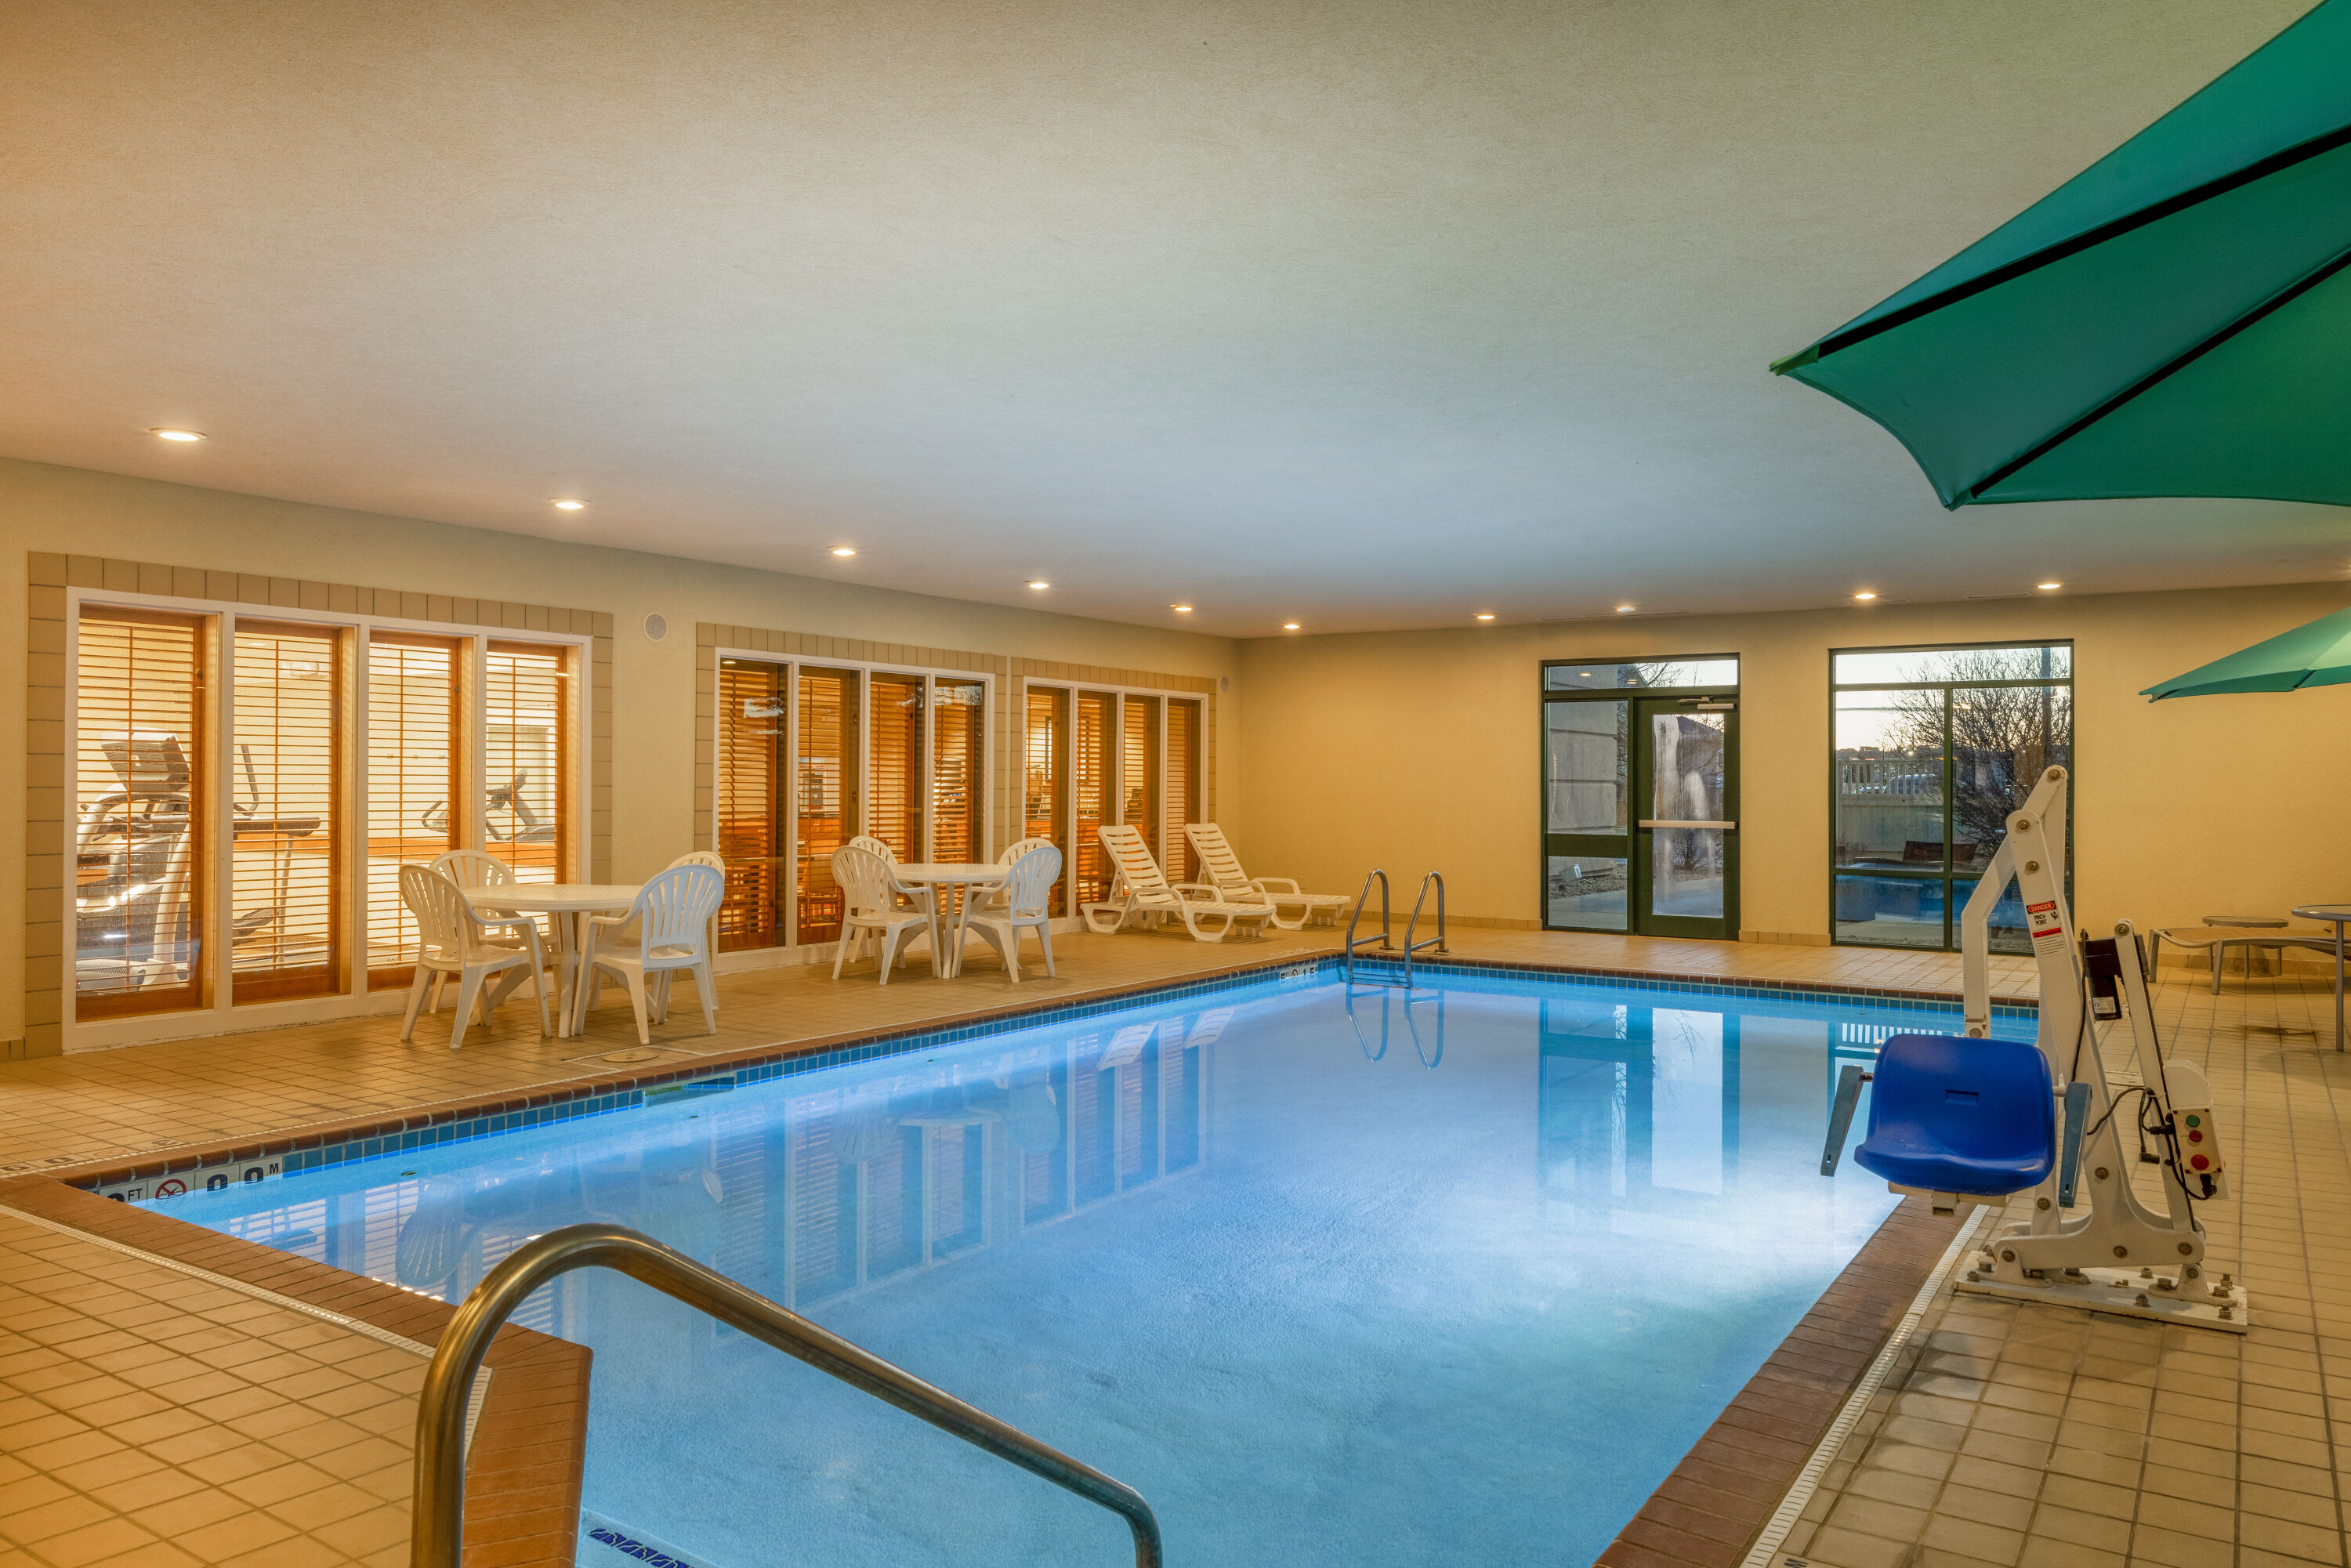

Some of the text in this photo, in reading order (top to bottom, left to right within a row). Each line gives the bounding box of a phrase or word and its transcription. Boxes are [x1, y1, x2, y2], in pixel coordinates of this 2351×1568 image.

[2030, 903, 2052, 912] DANGER
[270, 1163, 279, 1174] M
[129, 1188, 143, 1201] FT
